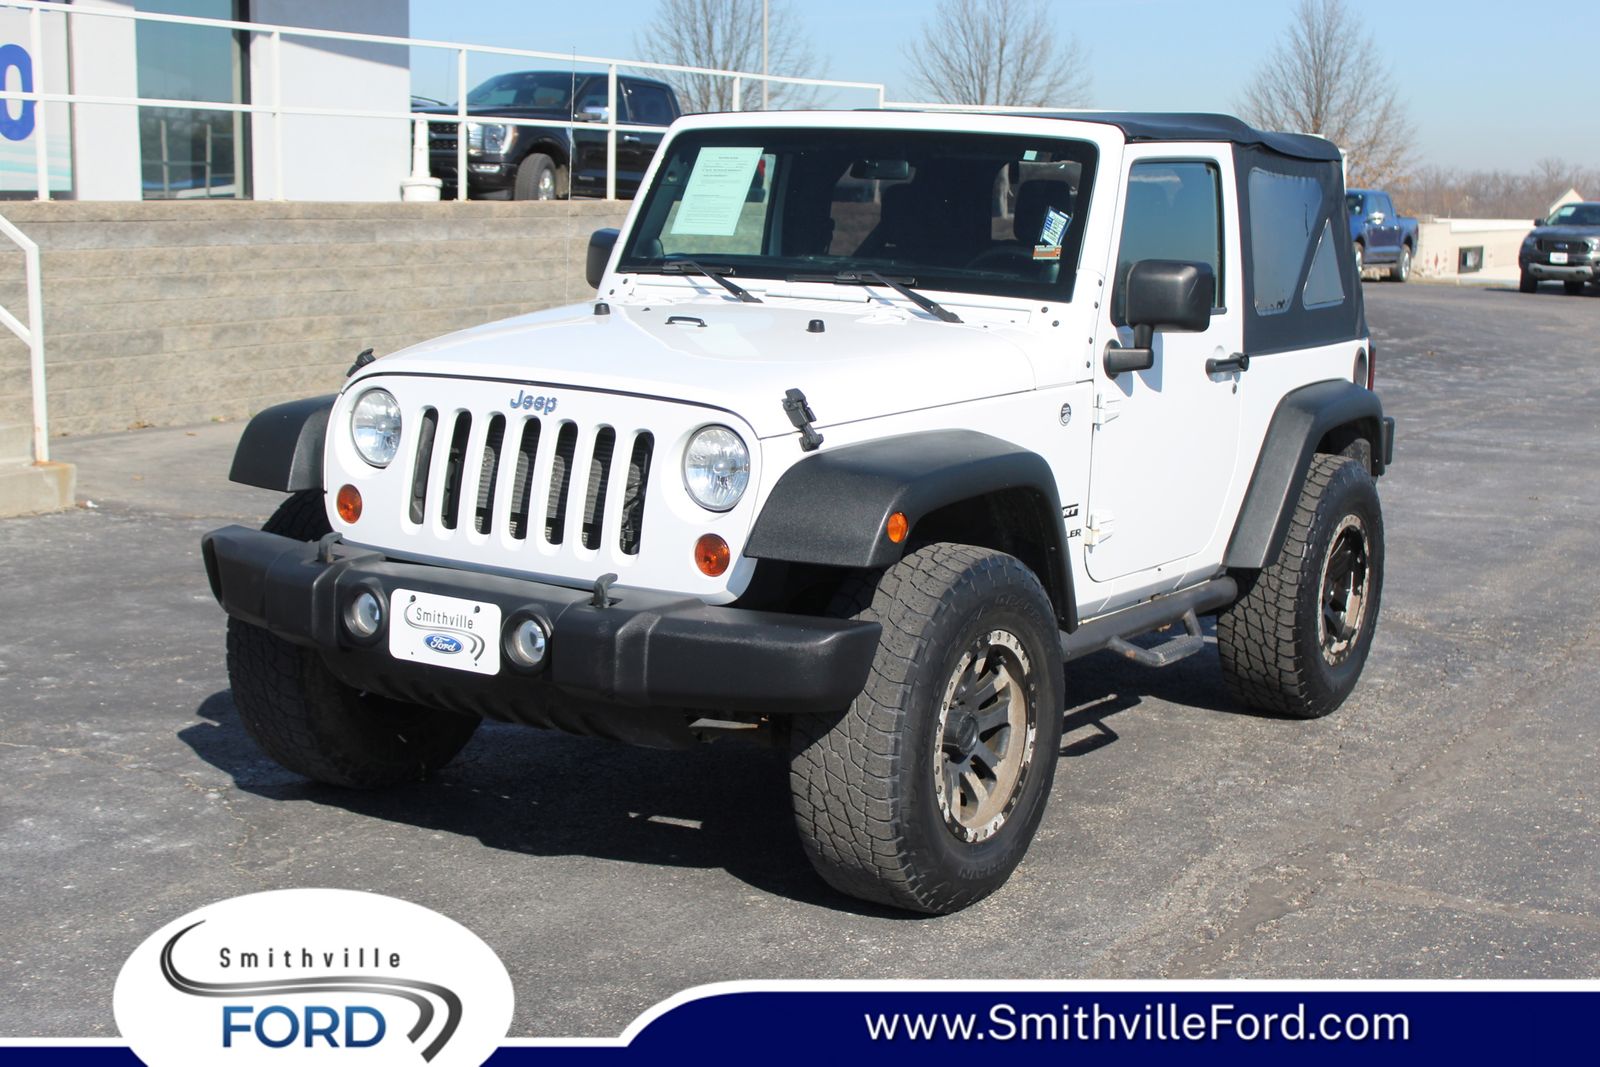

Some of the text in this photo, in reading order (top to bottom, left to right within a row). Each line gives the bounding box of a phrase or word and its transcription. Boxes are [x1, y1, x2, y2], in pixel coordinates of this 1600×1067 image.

[510, 389, 558, 415] Jeep
[416, 607, 474, 629] Smithville
[430, 635, 456, 652] Ford
